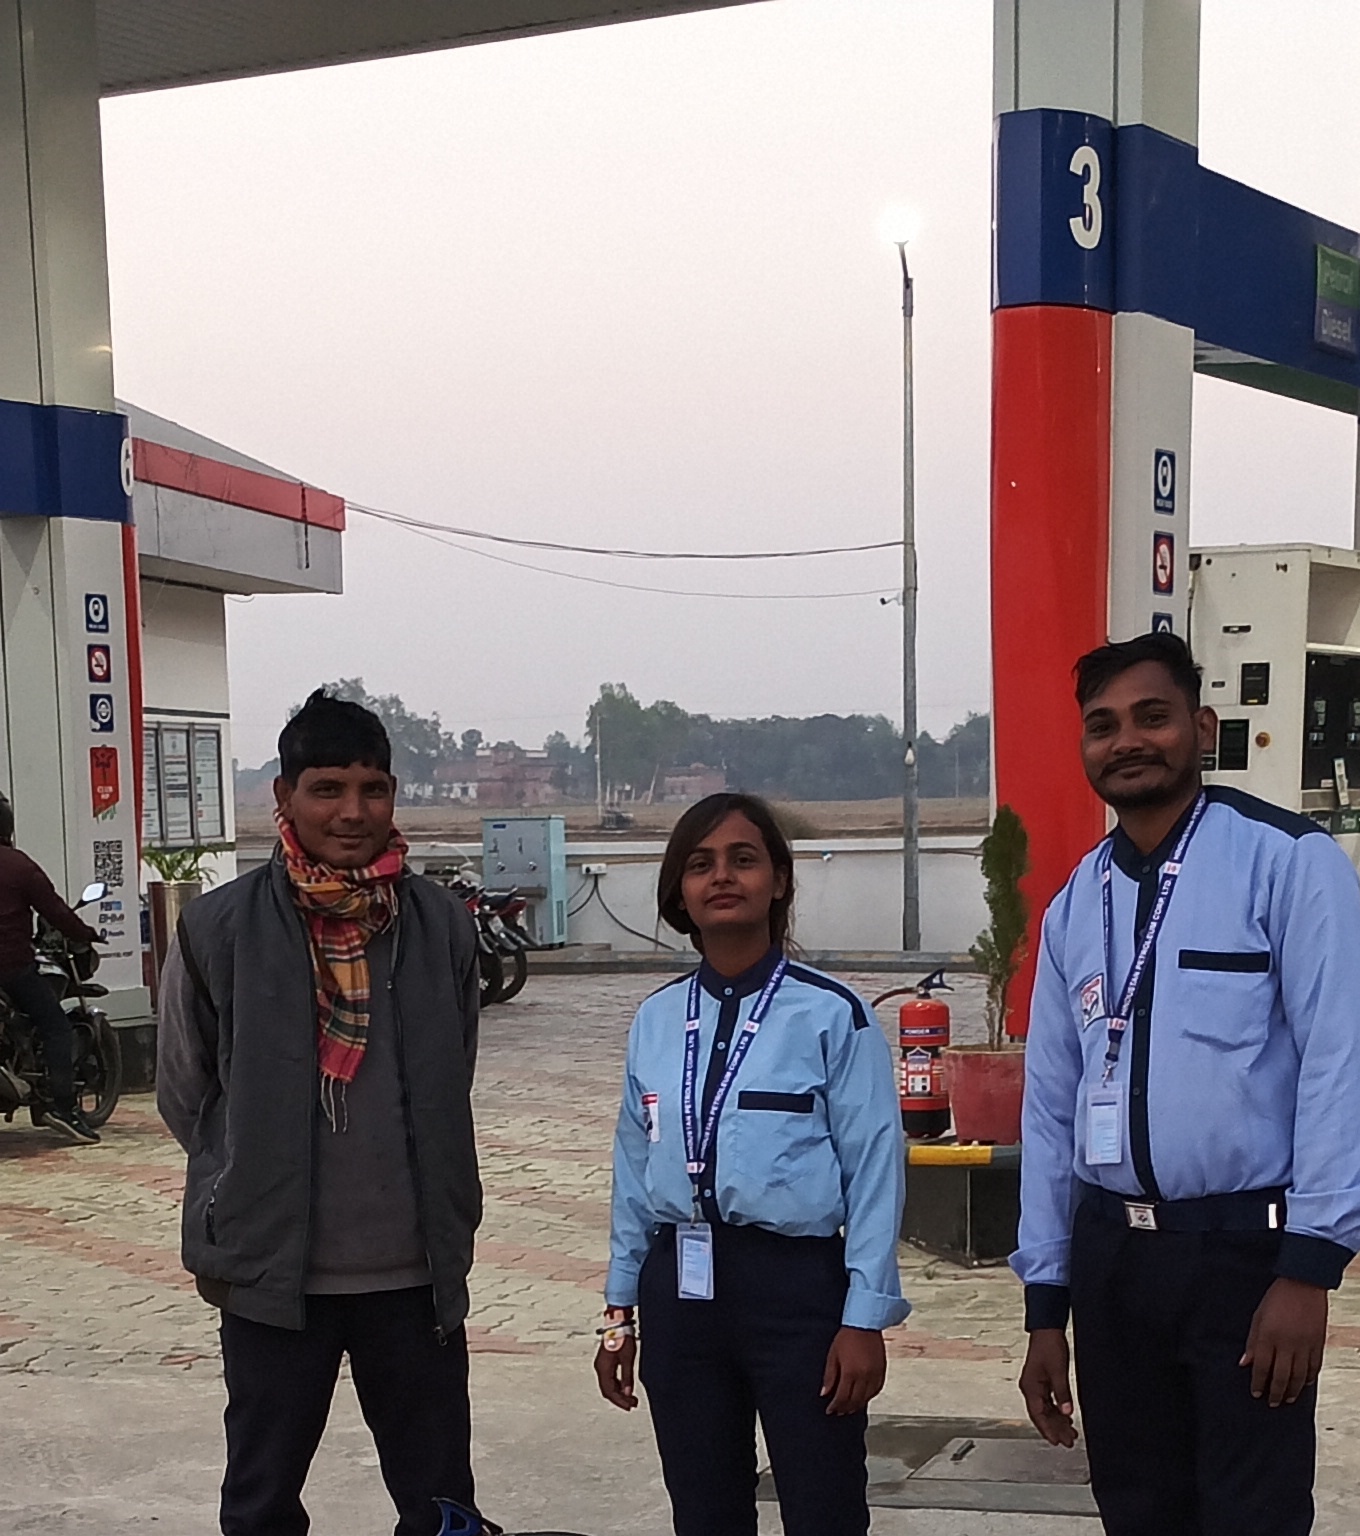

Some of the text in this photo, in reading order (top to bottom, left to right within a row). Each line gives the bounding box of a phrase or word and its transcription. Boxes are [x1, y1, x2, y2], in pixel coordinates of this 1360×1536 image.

[1069, 145, 1102, 249] 3
[1121, 971, 1141, 1017] HINDUSTAN
[1135, 921, 1157, 971] PETROLEUM
